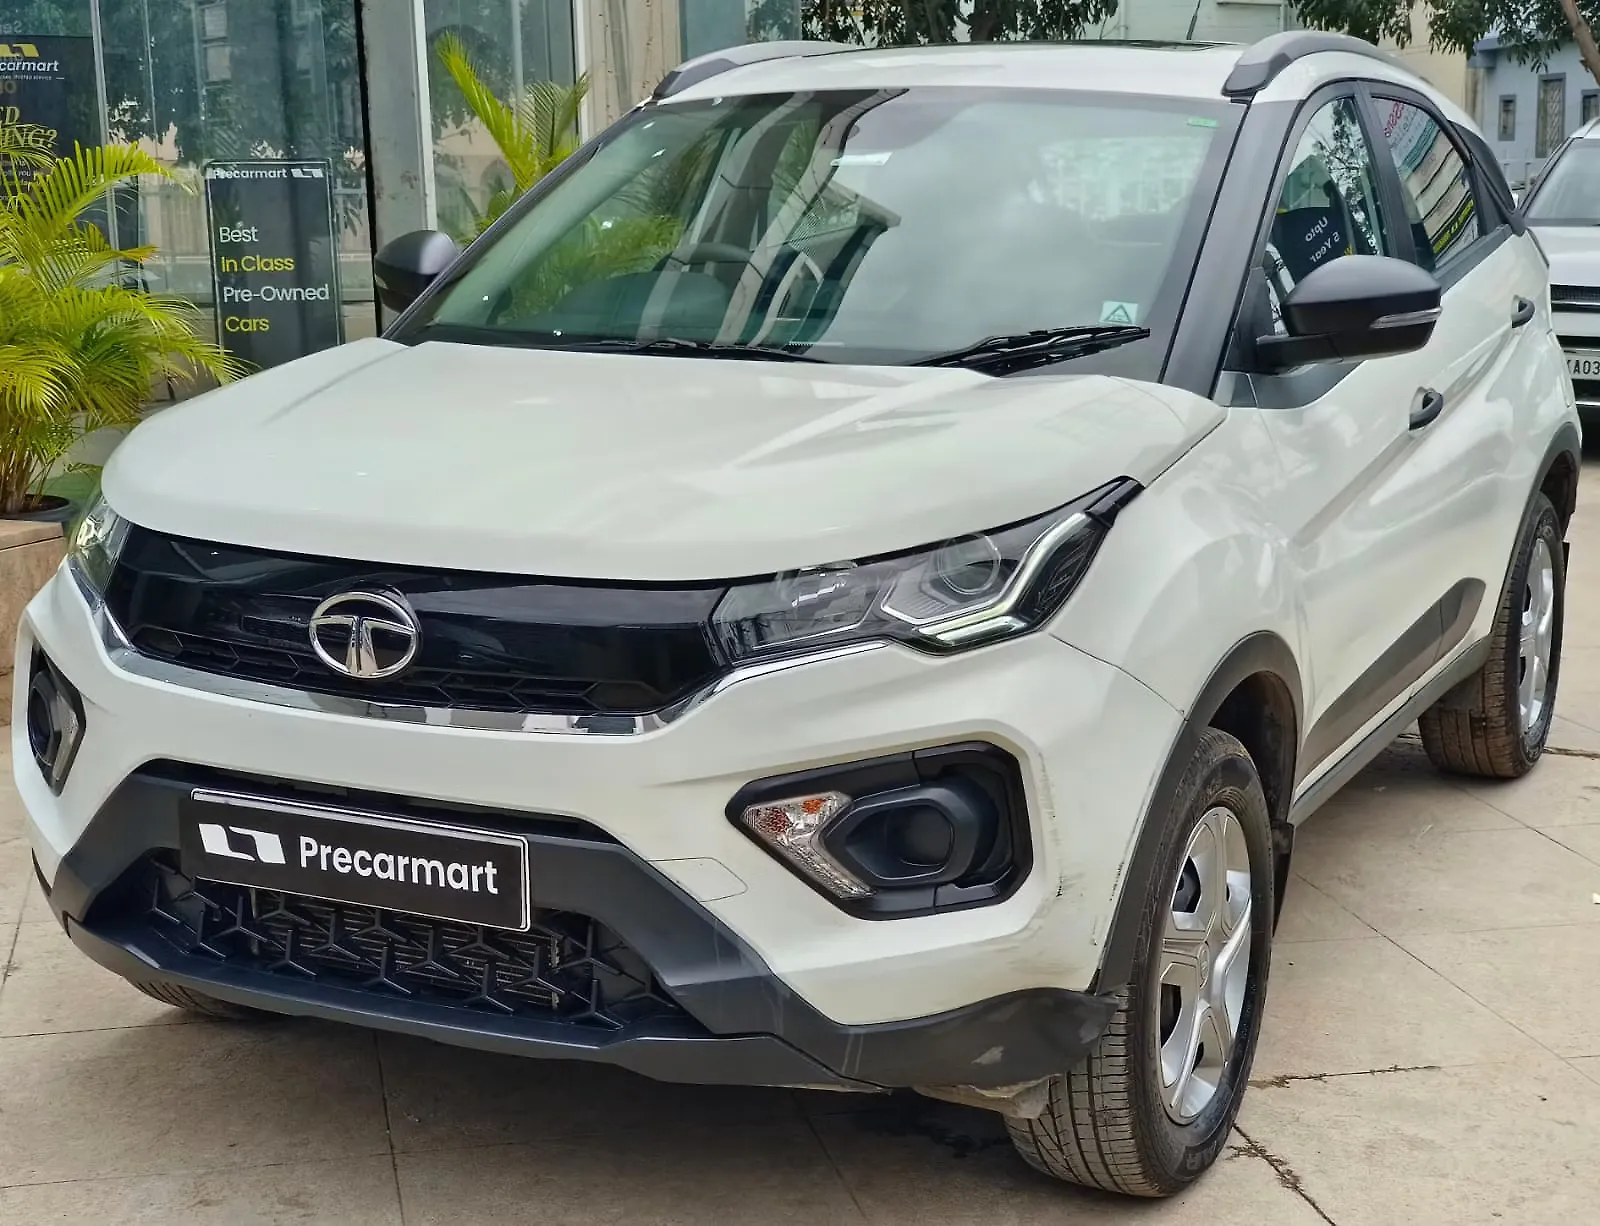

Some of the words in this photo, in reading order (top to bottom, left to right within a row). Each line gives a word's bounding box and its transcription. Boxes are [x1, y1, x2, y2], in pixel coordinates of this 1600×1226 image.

[213, 168, 288, 179] Precarmart
[219, 226, 260, 243] Best
[221, 256, 238, 272] In
[241, 254, 295, 272] Class
[223, 283, 330, 303] Pre-Owned
[225, 316, 270, 332] Cars
[299, 835, 499, 895] Precarmart
